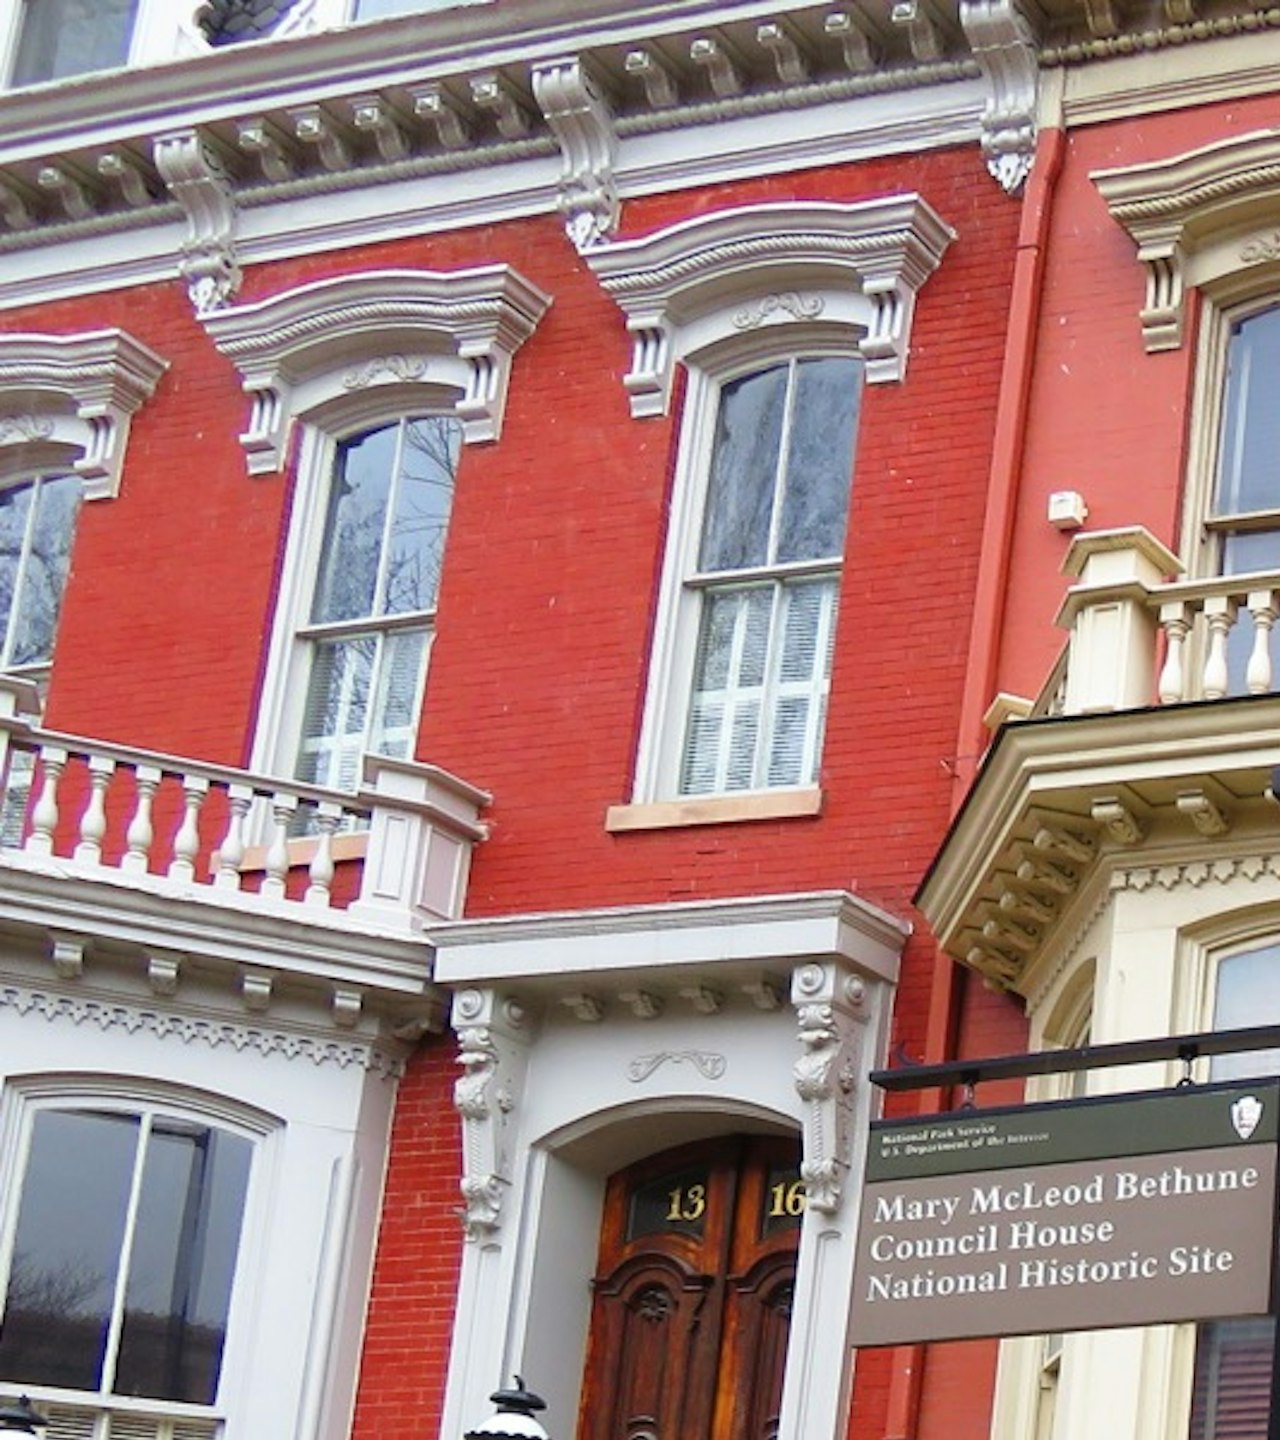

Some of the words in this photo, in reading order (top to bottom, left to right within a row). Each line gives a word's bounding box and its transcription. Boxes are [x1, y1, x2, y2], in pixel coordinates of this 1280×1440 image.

[881, 1130, 928, 1145] National
[930, 1127, 954, 1141] Park
[957, 1123, 997, 1137] Service
[904, 1138, 970, 1157] Department
[971, 1136, 984, 1149] of
[986, 1135, 1005, 1147] the
[665, 1184, 706, 1222] 13
[769, 1180, 806, 1217] 16
[873, 1194, 961, 1226] Mary
[969, 1174, 1104, 1216] McLeod
[1115, 1166, 1259, 1201] Bethune
[870, 1223, 999, 1263] Council
[1008, 1220, 1115, 1251] House
[866, 1262, 1008, 1301] National
[1018, 1251, 1159, 1288] Historic
[1168, 1245, 1234, 1277] Site
